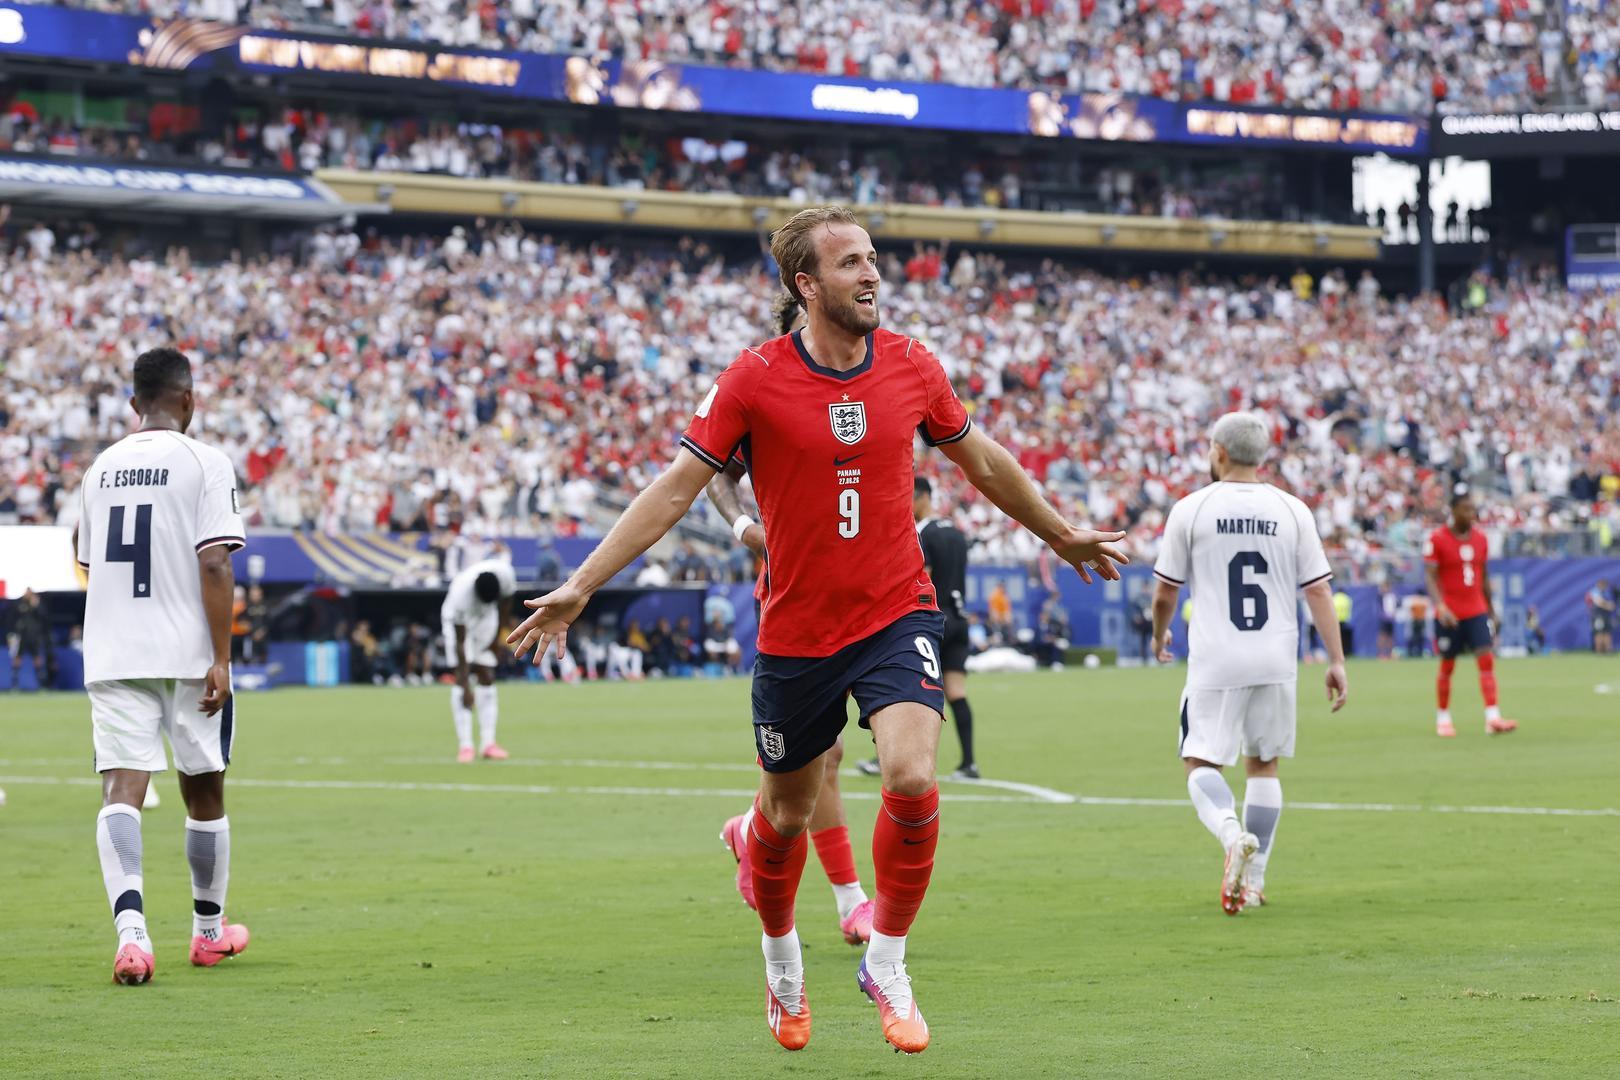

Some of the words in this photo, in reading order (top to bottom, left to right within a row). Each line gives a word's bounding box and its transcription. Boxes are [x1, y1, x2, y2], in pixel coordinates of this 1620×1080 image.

[100, 471, 110, 488] F.
[114, 468, 169, 487] ESCOBAR
[837, 469, 861, 477] PANAMA
[838, 488, 860, 539] 9
[1216, 515, 1278, 537] MARTÍNEZ
[105, 504, 152, 598] 4
[1228, 551, 1268, 631] 6
[914, 636, 940, 680] 9
